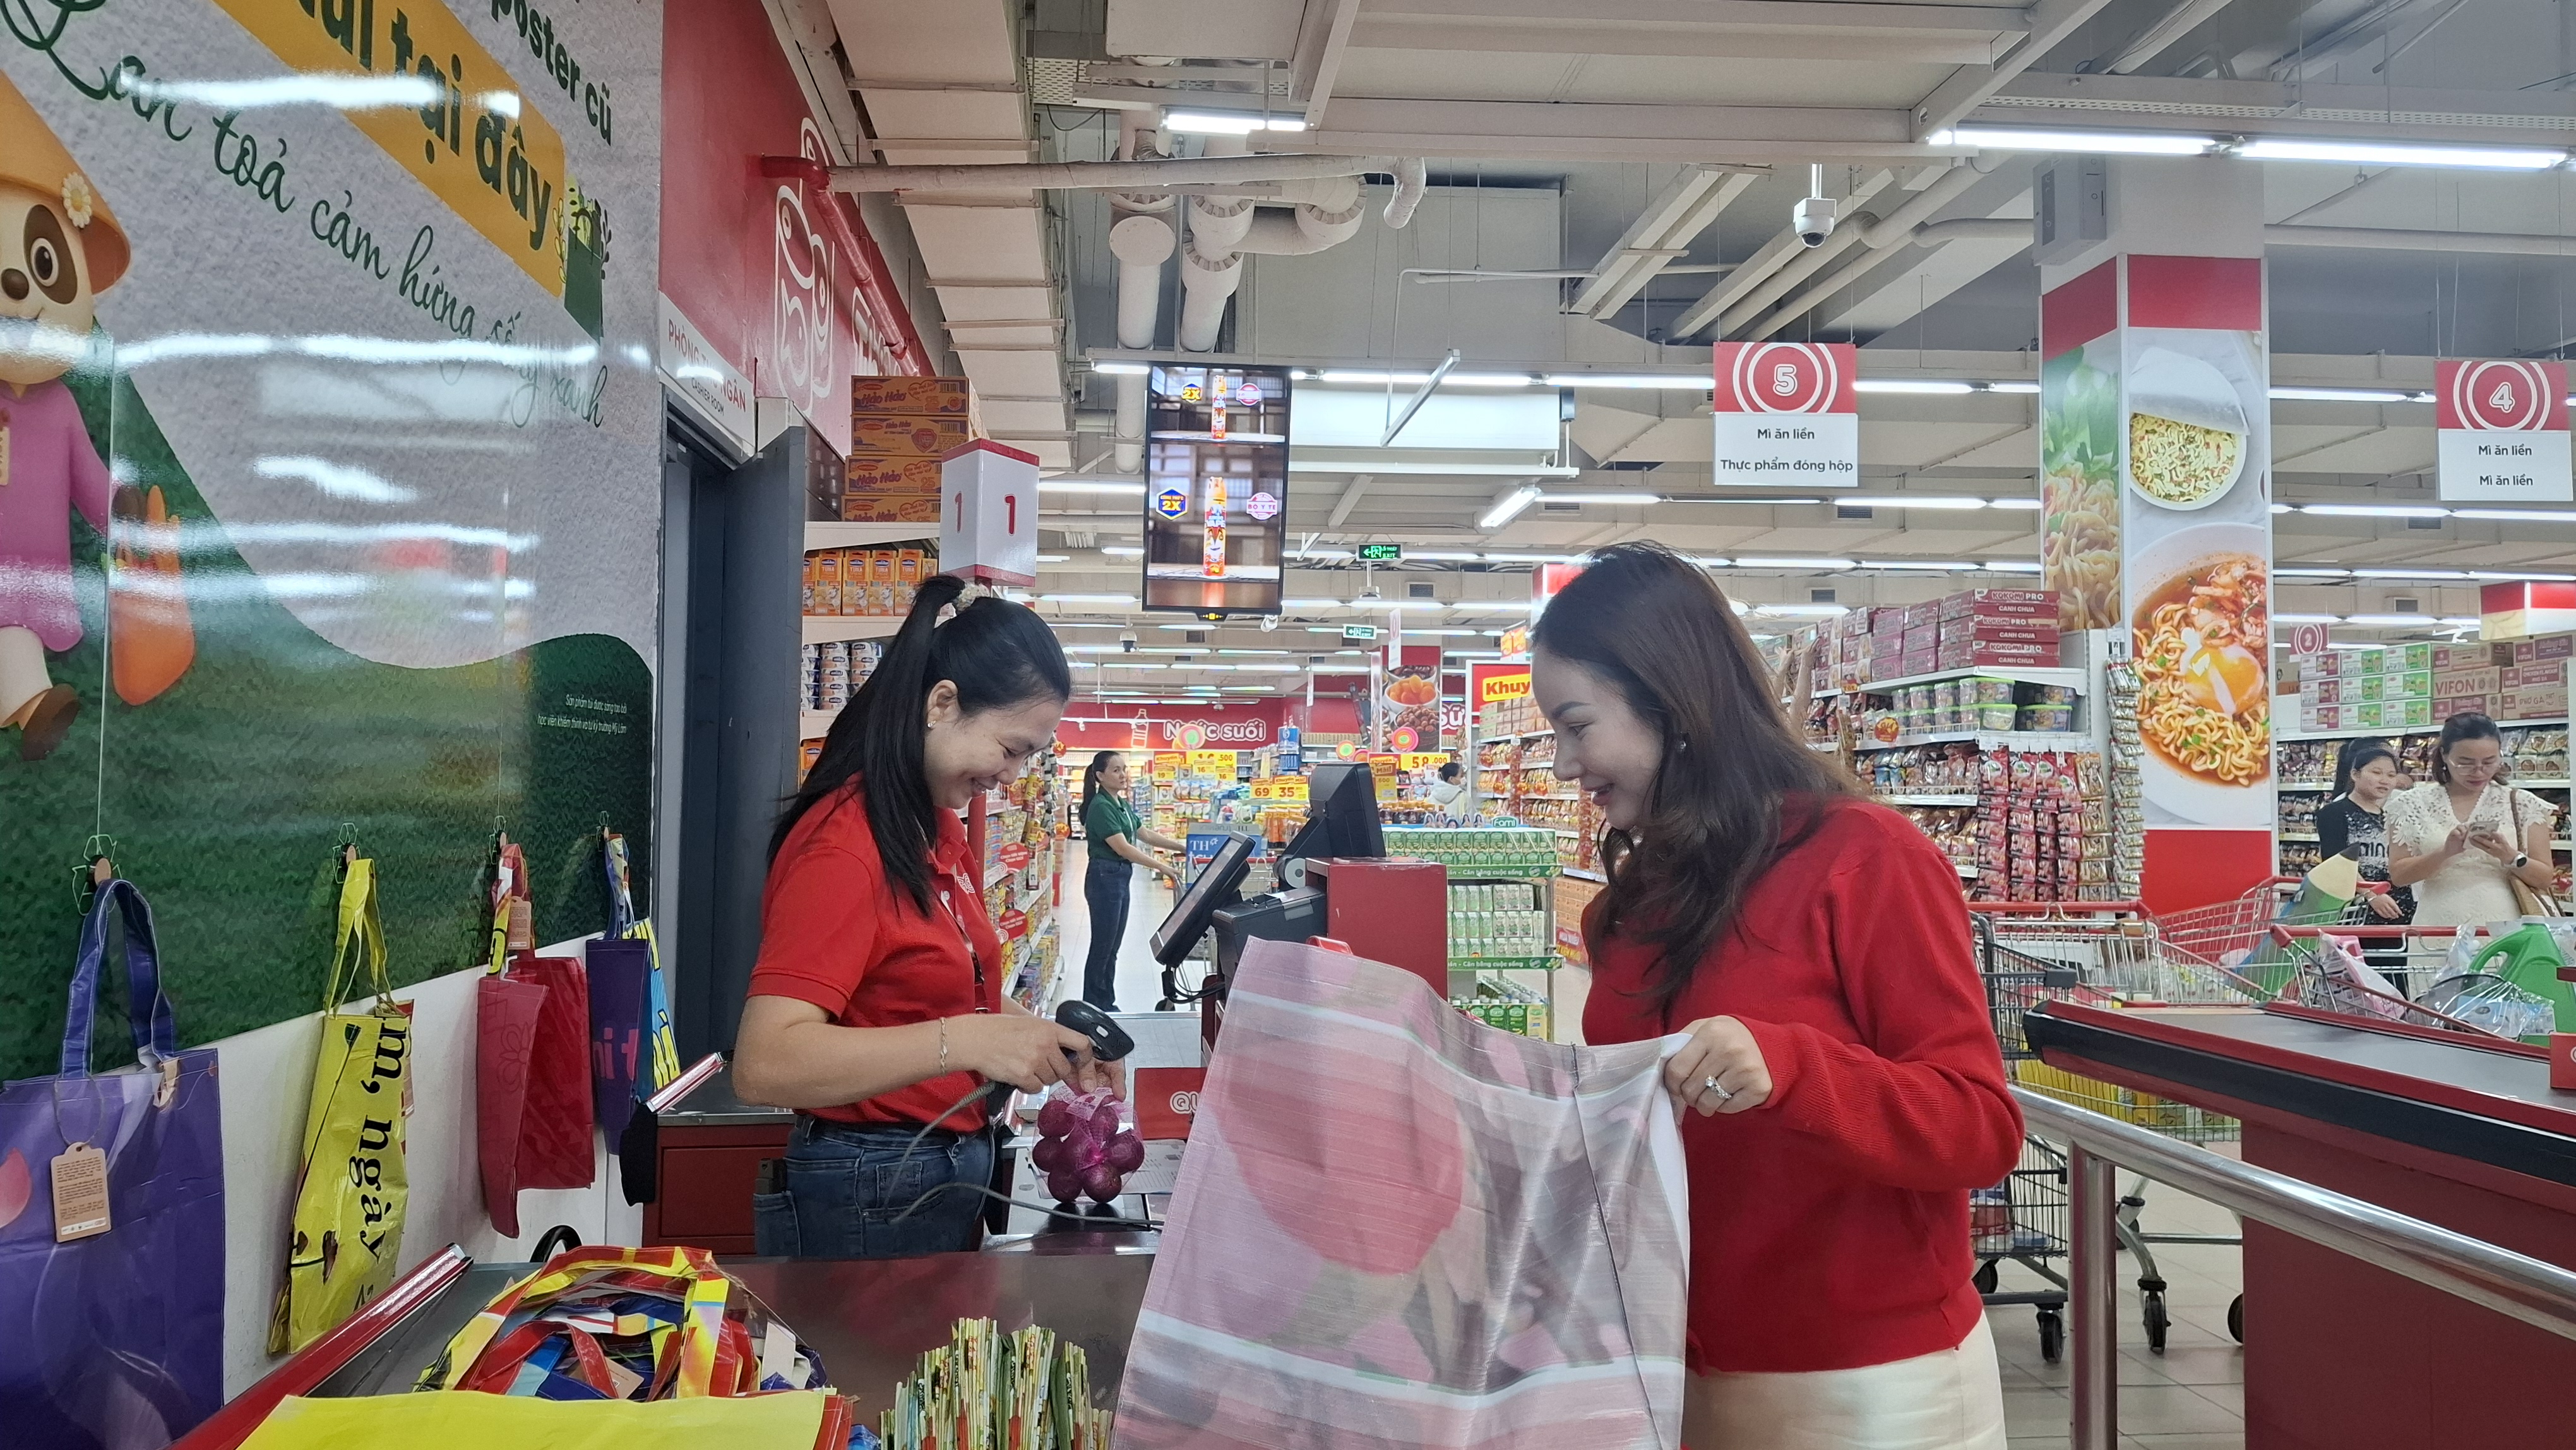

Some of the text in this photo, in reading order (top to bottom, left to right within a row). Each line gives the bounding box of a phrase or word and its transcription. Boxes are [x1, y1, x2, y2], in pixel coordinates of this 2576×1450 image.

[585, 82, 611, 146] cũ
[311, 189, 390, 279] cảm
[669, 318, 700, 368] PHÒNG
[720, 376, 746, 412] NGÂN
[1773, 364, 1798, 397] 5
[1182, 389, 1202, 400] 2X
[2489, 381, 2515, 413] 4
[711, 394, 724, 416] ROOM
[1757, 427, 1815, 439] Mì ăn liền
[2478, 443, 2532, 455] Mì ăn liền
[1720, 457, 1853, 473] Thực phẩm đóng hộp
[2479, 473, 2533, 486] Mì ăn liền
[954, 491, 963, 534] 1
[1162, 501, 1182, 512] 2X
[1005, 494, 1017, 536] 1
[1992, 591, 2024, 600] KOKOMI
[1989, 643, 2022, 651] KOKOMI
[2305, 633, 2313, 647] 2
[2435, 678, 2475, 695] VIFON
[1220, 719, 1266, 741] suối
[1255, 787, 1270, 797] 69
[1279, 786, 1295, 798] 35
[1494, 818, 1516, 827] Fami
[1190, 840, 1209, 851] TH
[349, 1115, 392, 1264] ngày
